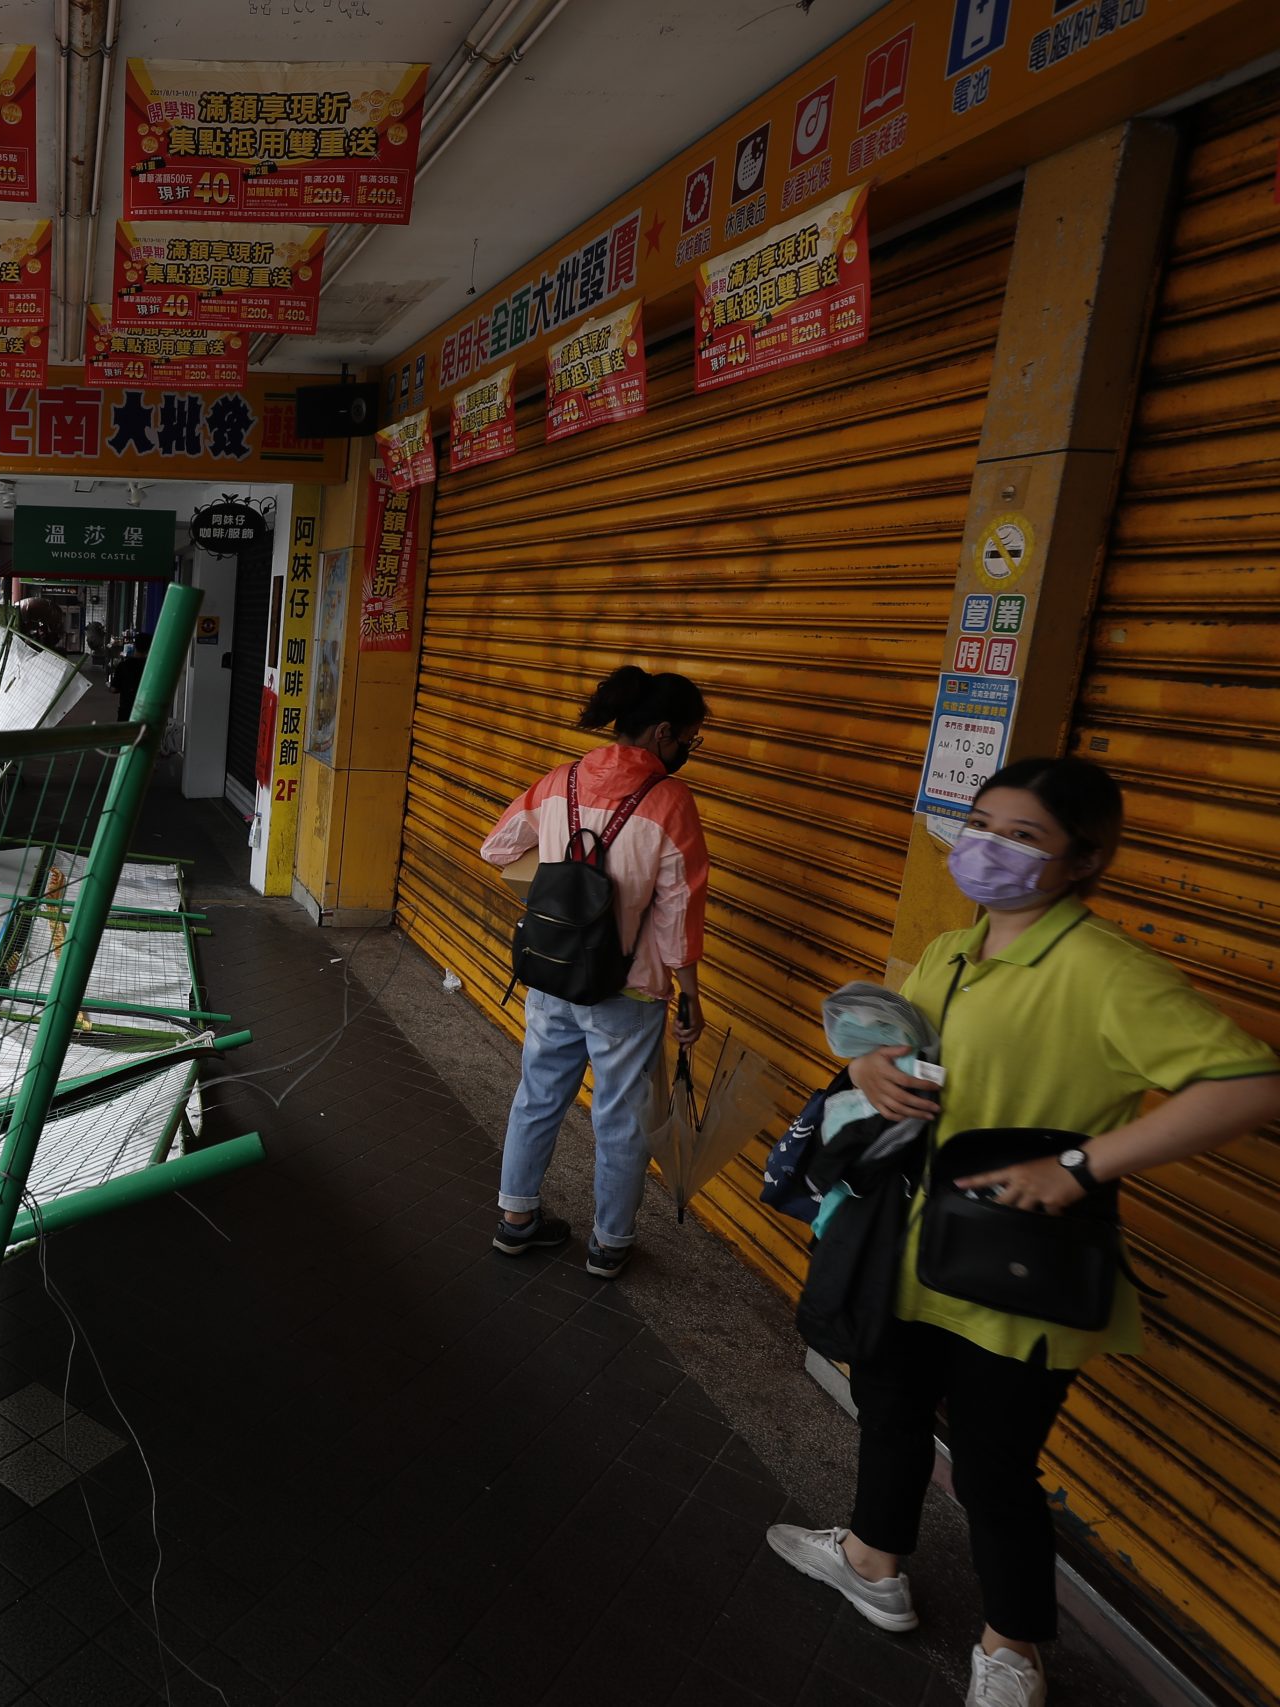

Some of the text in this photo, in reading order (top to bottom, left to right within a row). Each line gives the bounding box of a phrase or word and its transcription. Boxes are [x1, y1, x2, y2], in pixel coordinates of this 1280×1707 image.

[951, 65, 990, 116] 電池
[146, 100, 196, 123] 開學期
[198, 91, 351, 124] 滿額享現折
[168, 126, 378, 160] 集點抵用雙重送
[848, 113, 908, 176] 圖書雜誌
[304, 175, 345, 184] 集滿20點
[360, 174, 398, 184] 集滿35點
[167, 239, 274, 264] 滿額享現折
[144, 264, 293, 288] 集點抵用雙重送
[711, 253, 840, 328] 集點抵用雙重送
[110, 336, 225, 356] 集點抵用雙重送
[211, 514, 246, 526] 阿妹仔
[45, 524, 144, 548] 溫莎堡
[199, 527, 255, 539] 咖啡/服飾
[373, 489, 410, 597] 滿額享現折
[51, 551, 136, 561] WINDSOR CASTLE
[289, 517, 315, 619] 阿妹仔
[364, 612, 410, 633] 大特賣
[965, 600, 1021, 629] 營業
[957, 642, 1013, 671] 時間
[955, 738, 994, 756] 10:30
[275, 779, 298, 801] 2F
